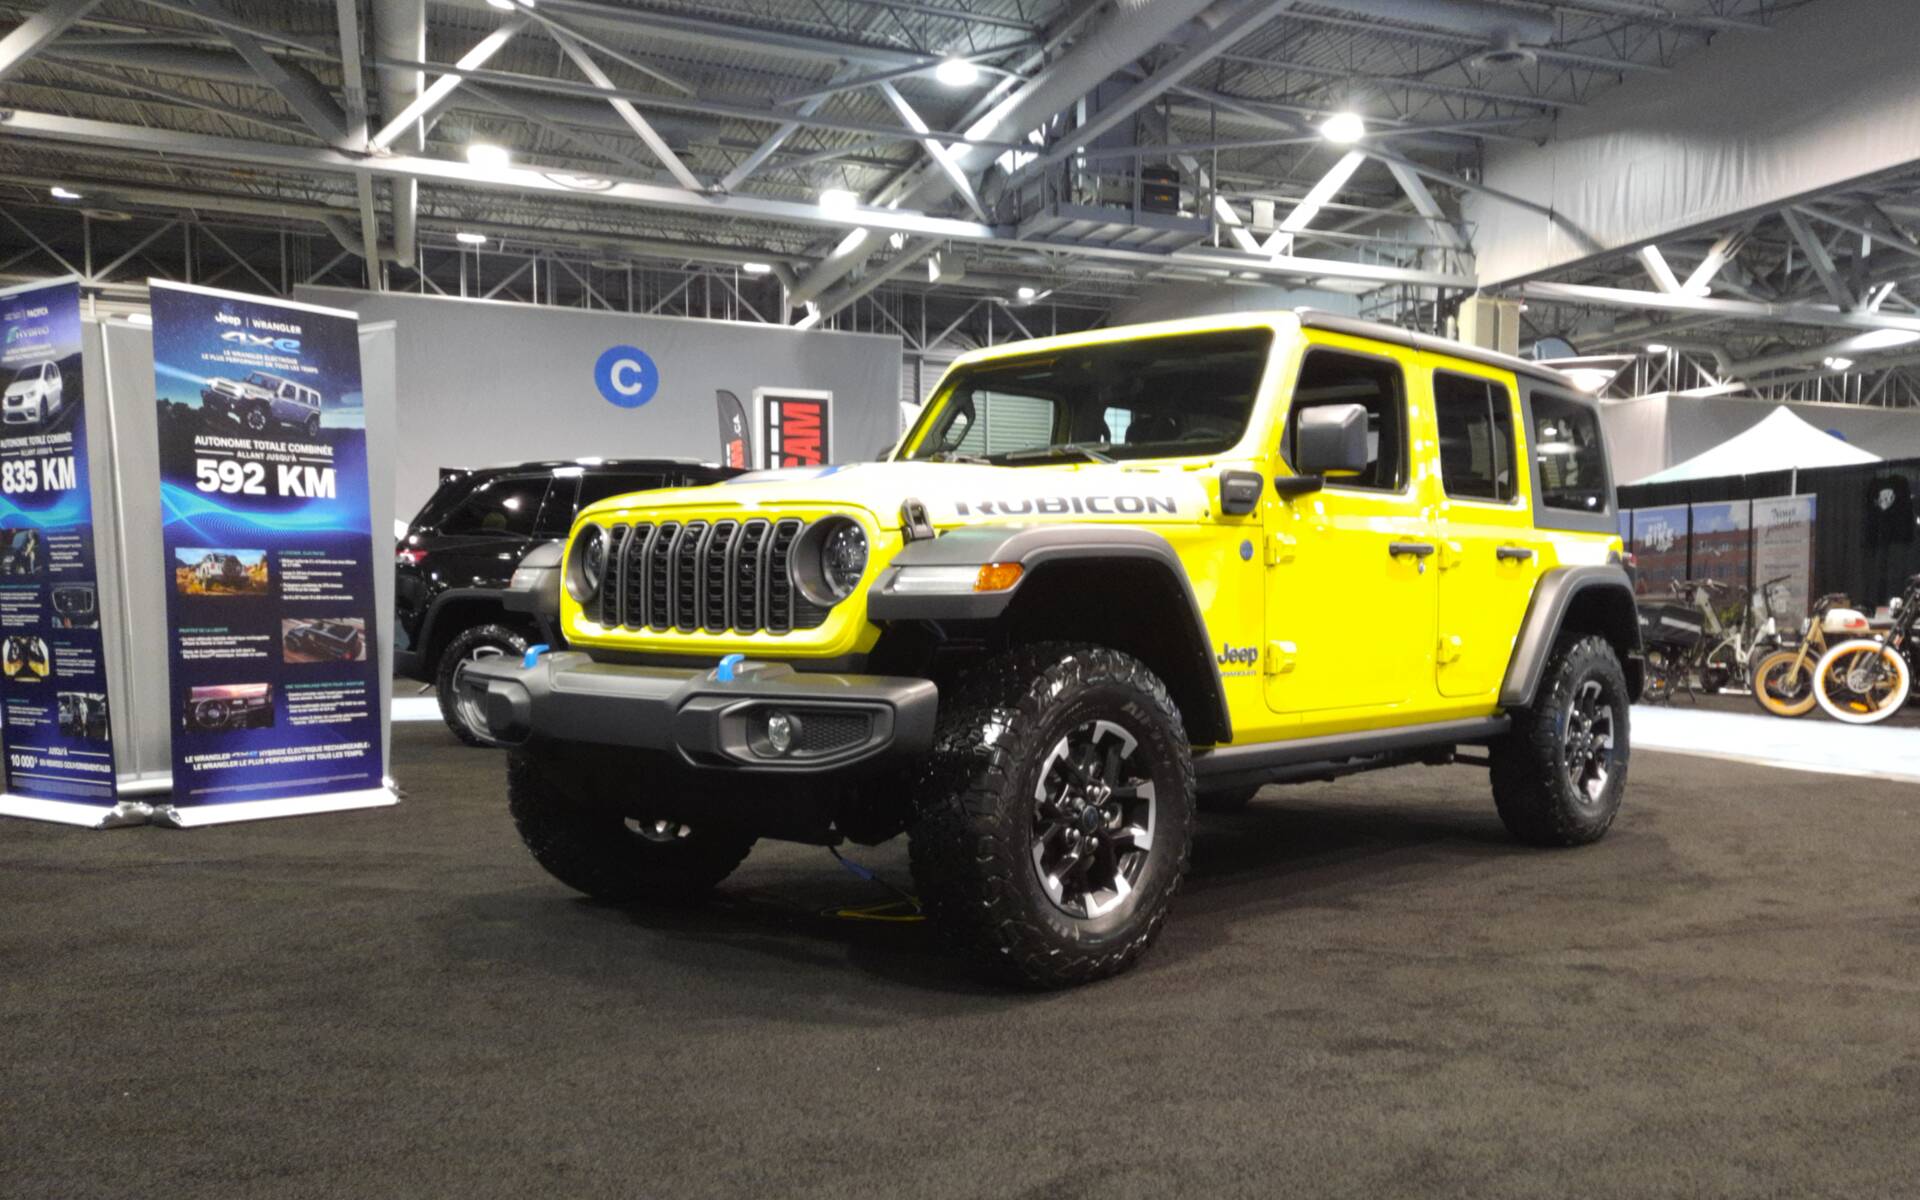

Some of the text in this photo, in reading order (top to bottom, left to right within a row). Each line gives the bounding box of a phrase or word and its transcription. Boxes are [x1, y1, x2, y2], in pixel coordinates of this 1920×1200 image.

[214, 311, 302, 334] Jeep WRANGLER
[611, 358, 642, 396] C
[194, 435, 334, 456] AUTONOMIE TOTALE COMBINÉE
[236, 451, 264, 461] ALLANT
[2, 456, 76, 494] 835 KM
[195, 458, 337, 499] 592 KM
[954, 496, 1178, 517] RUBICON
[1217, 642, 1258, 667] Jeep
